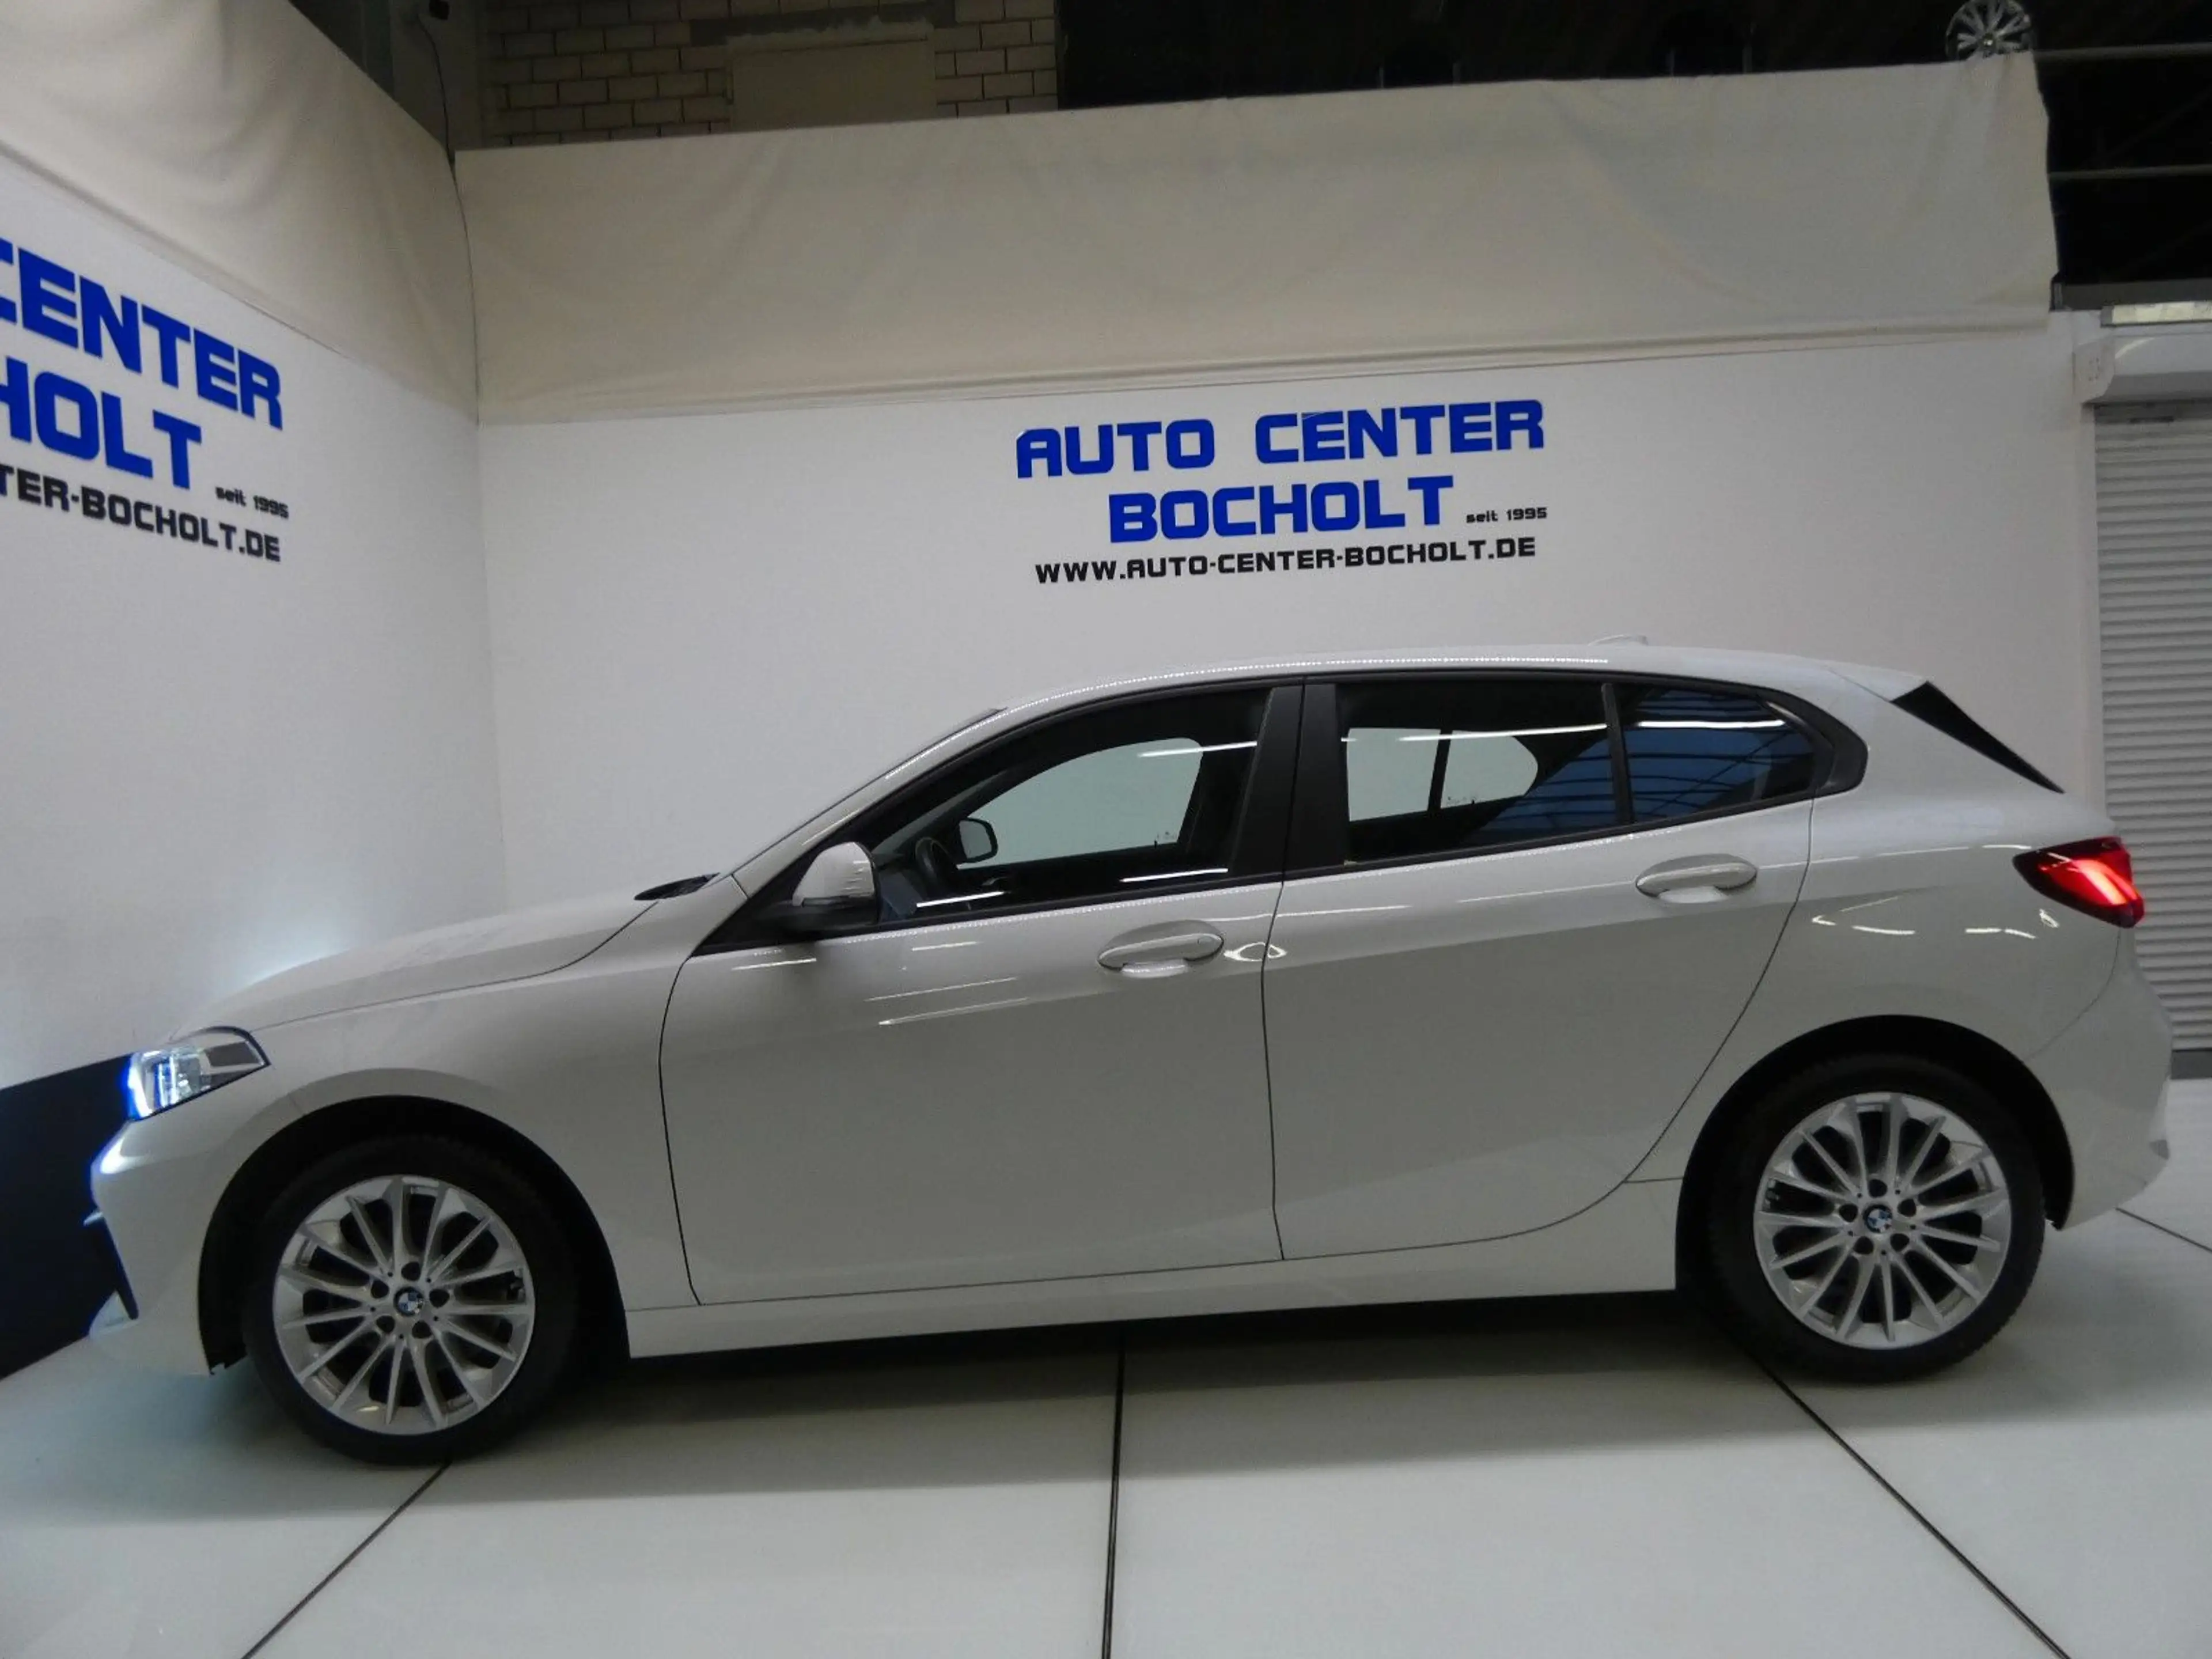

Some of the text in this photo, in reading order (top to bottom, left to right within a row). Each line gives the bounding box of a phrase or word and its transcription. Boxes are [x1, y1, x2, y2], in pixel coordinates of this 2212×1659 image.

[0, 236, 282, 430] ENTER
[1016, 399, 1544, 478] AUTO CENTER
[0, 463, 281, 562] TER-BOCHOLT.DE
[215, 486, 246, 507] seit
[253, 495, 289, 519] 1995
[1109, 475, 1547, 543] BOCHOLT seit 1995
[1035, 536, 1536, 584] WWW.AUTO-CENTER-BOCHOLT.DE
